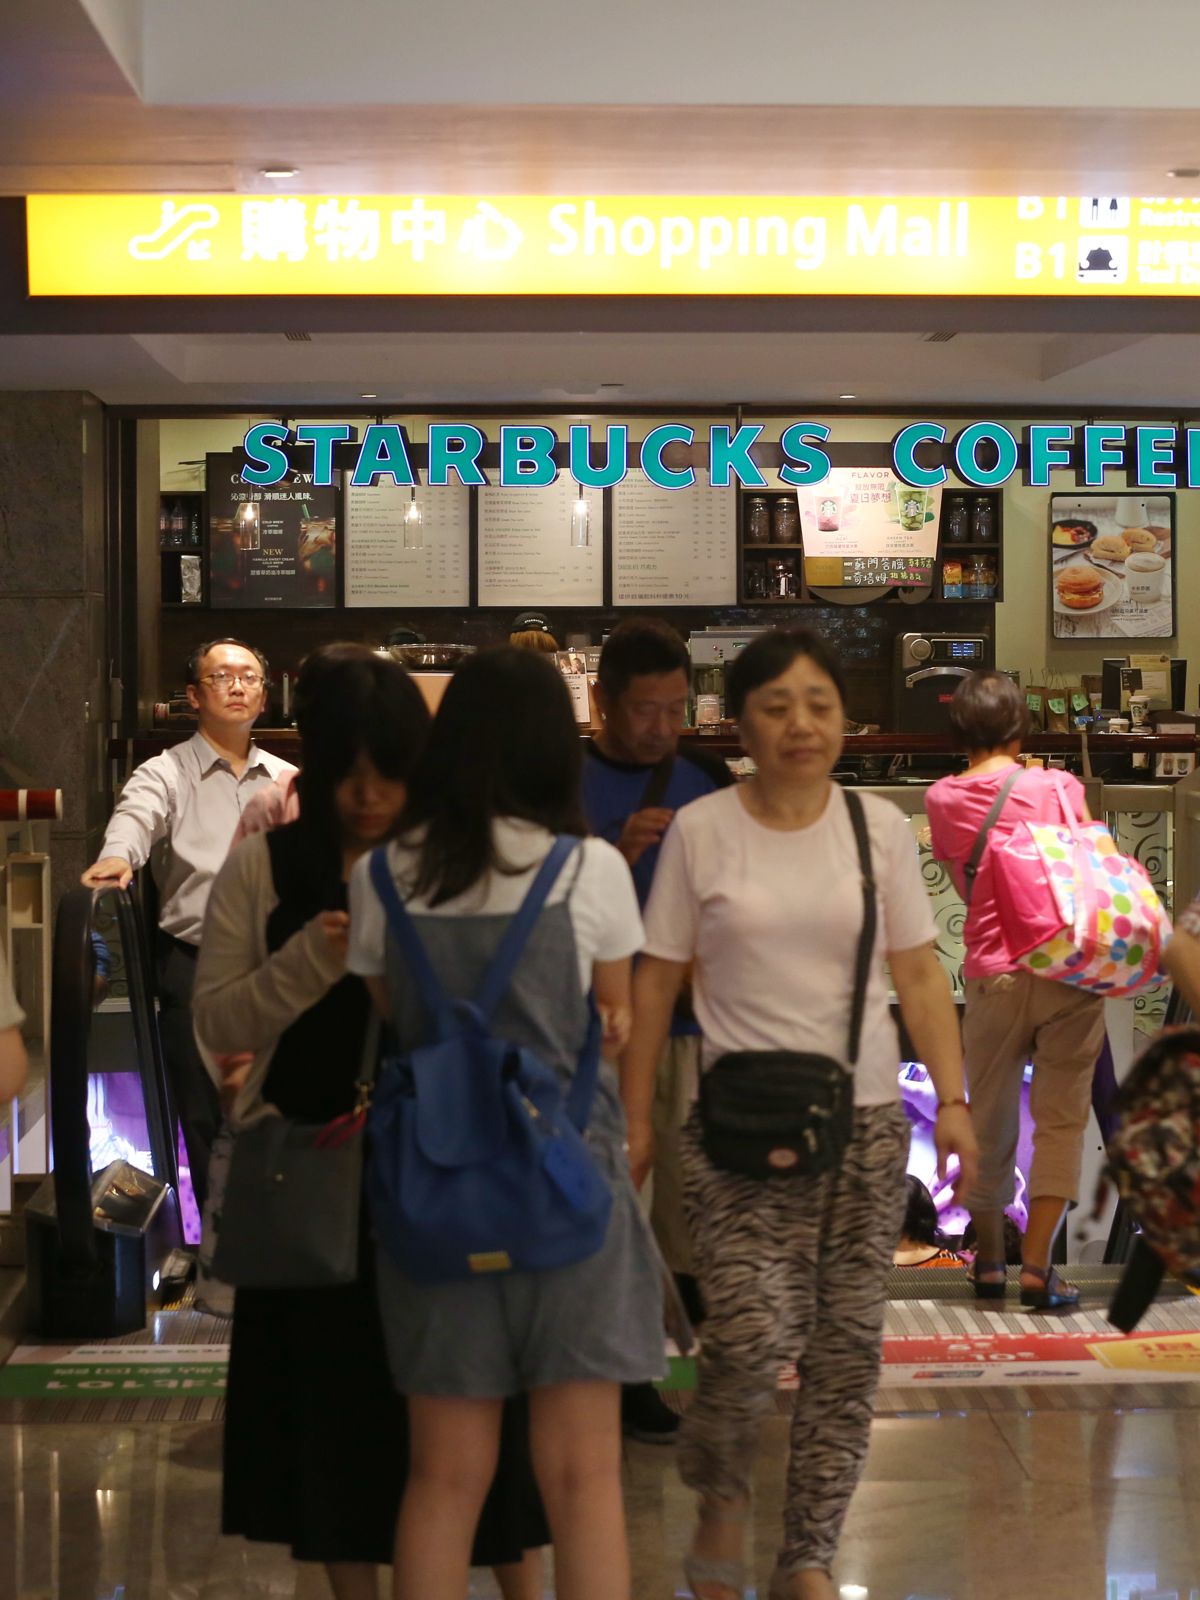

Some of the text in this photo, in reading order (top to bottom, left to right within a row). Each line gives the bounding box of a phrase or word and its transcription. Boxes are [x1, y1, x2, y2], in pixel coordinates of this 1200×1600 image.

[240, 200, 526, 262] 購物中心
[548, 202, 970, 269] Shopping Mall
[1015, 242, 1067, 280] B1
[241, 421, 832, 489] STARBUCKS
[851, 471, 890, 479] FLAVOR
[262, 548, 284, 556] NEW
